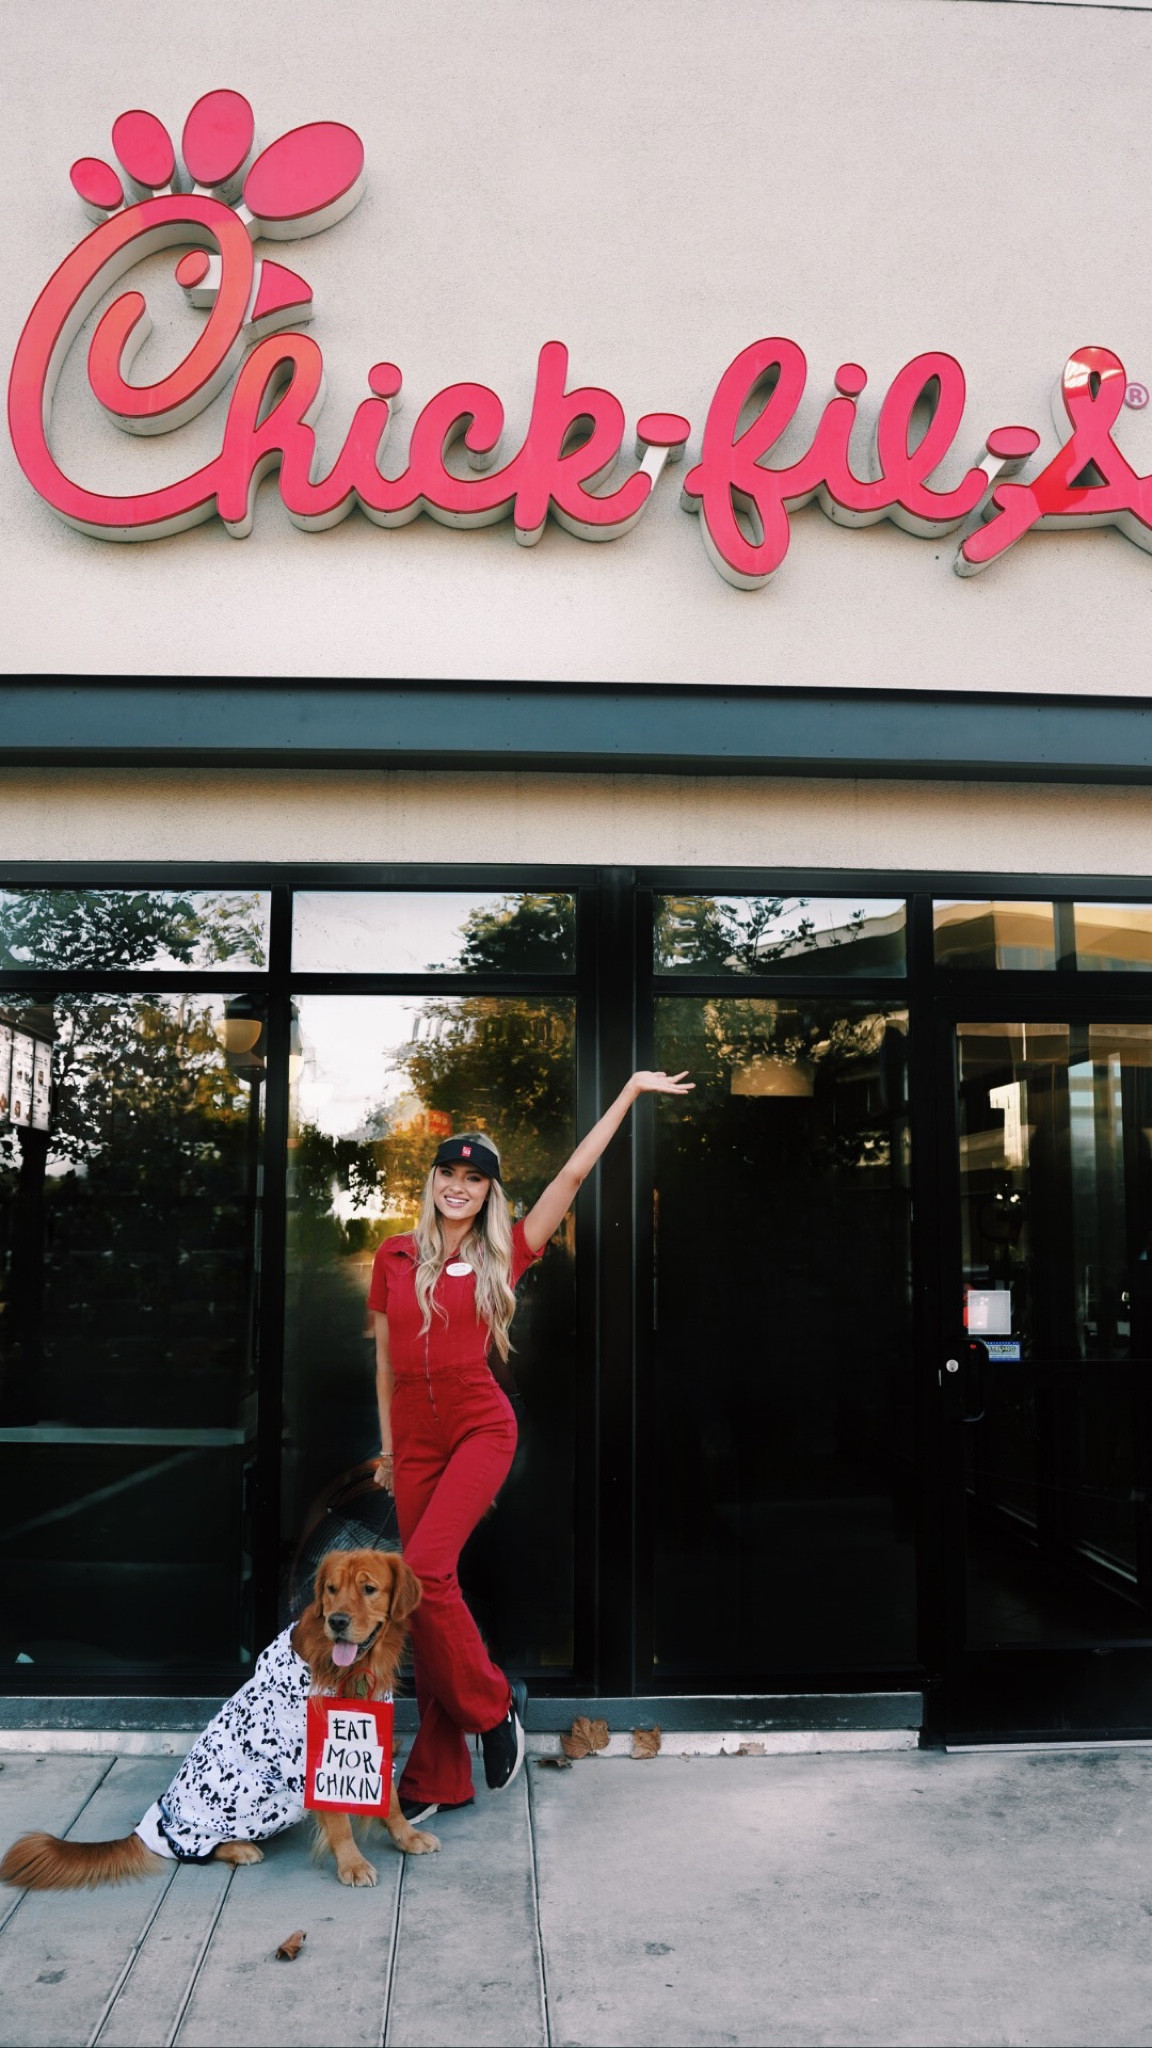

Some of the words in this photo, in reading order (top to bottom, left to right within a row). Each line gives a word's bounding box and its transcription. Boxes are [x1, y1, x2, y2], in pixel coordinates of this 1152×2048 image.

[333, 1718, 372, 1741] EAT
[327, 1744, 376, 1773] MOR
[316, 1772, 381, 1801] CHIKIN
